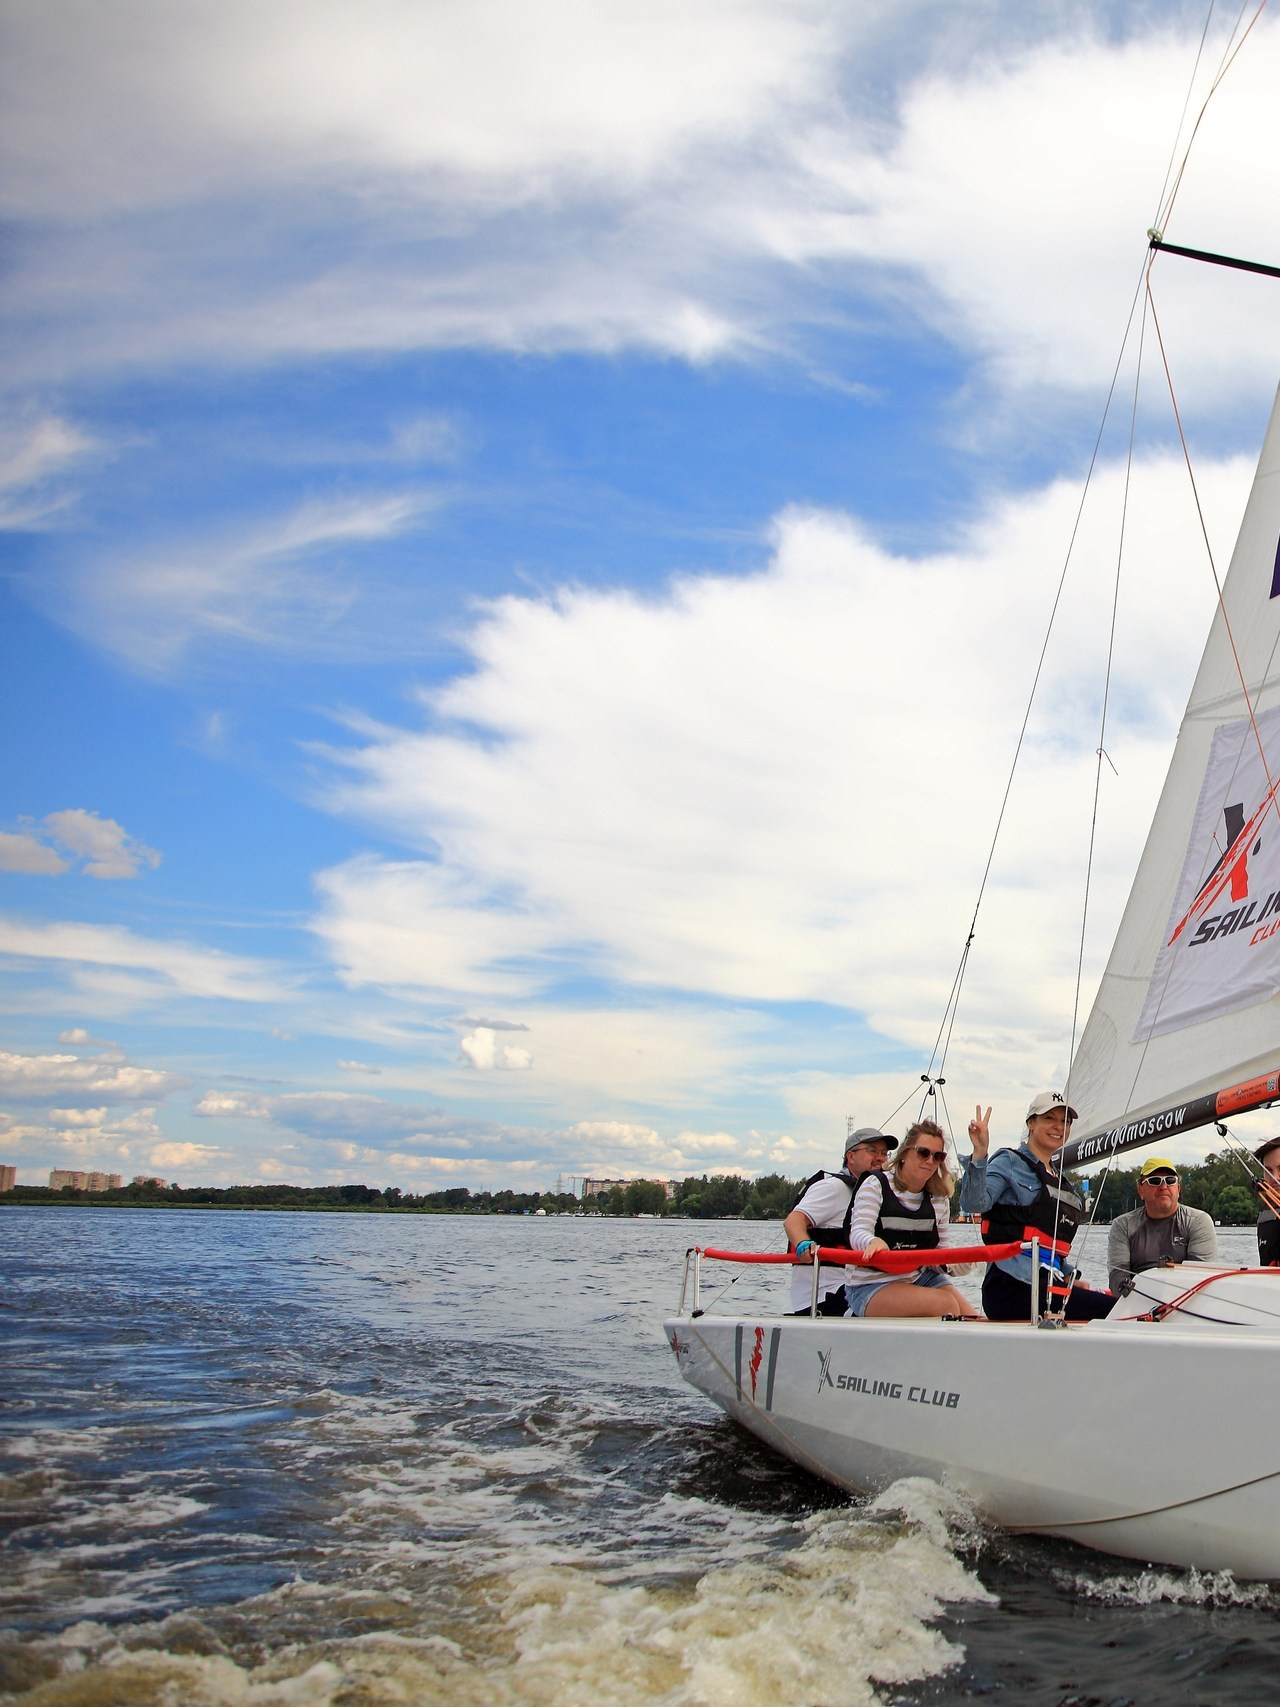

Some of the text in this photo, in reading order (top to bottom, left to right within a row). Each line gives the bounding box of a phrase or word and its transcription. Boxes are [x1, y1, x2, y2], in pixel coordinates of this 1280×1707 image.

[1077, 1107, 1187, 1161] #mx700moscow
[836, 1374, 903, 1399] SAILING
[907, 1386, 960, 1409] CLUB
